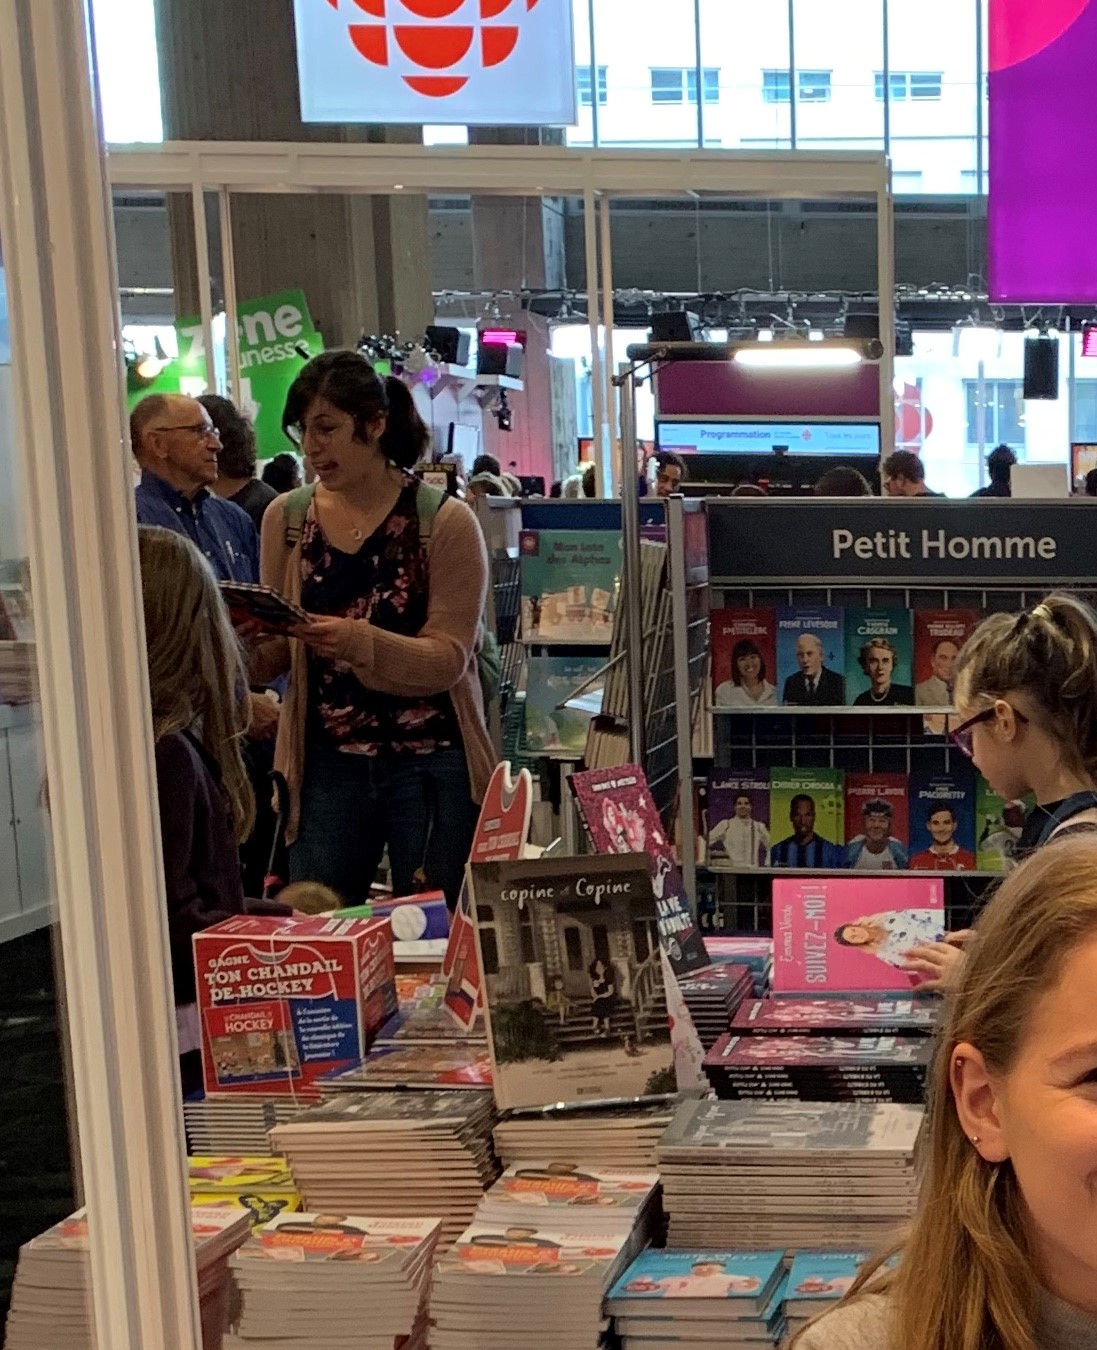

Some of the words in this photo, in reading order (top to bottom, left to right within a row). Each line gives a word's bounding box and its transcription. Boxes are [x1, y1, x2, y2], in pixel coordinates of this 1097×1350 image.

[181, 304, 302, 359] zne
[238, 339, 311, 369] unesse
[700, 429, 771, 440] Programmation
[833, 529, 911, 558] Petit
[921, 529, 1057, 558] Homme
[712, 781, 739, 790] LANCE
[501, 887, 554, 910] copine
[575, 877, 632, 905] Copine
[204, 970, 242, 986] TON
[247, 959, 343, 981] CHANDAIL
[208, 955, 250, 968] GAGNE
[210, 986, 235, 1001] DE
[239, 978, 314, 998] HOCKEY
[225, 1019, 273, 1033] HOCKEY
